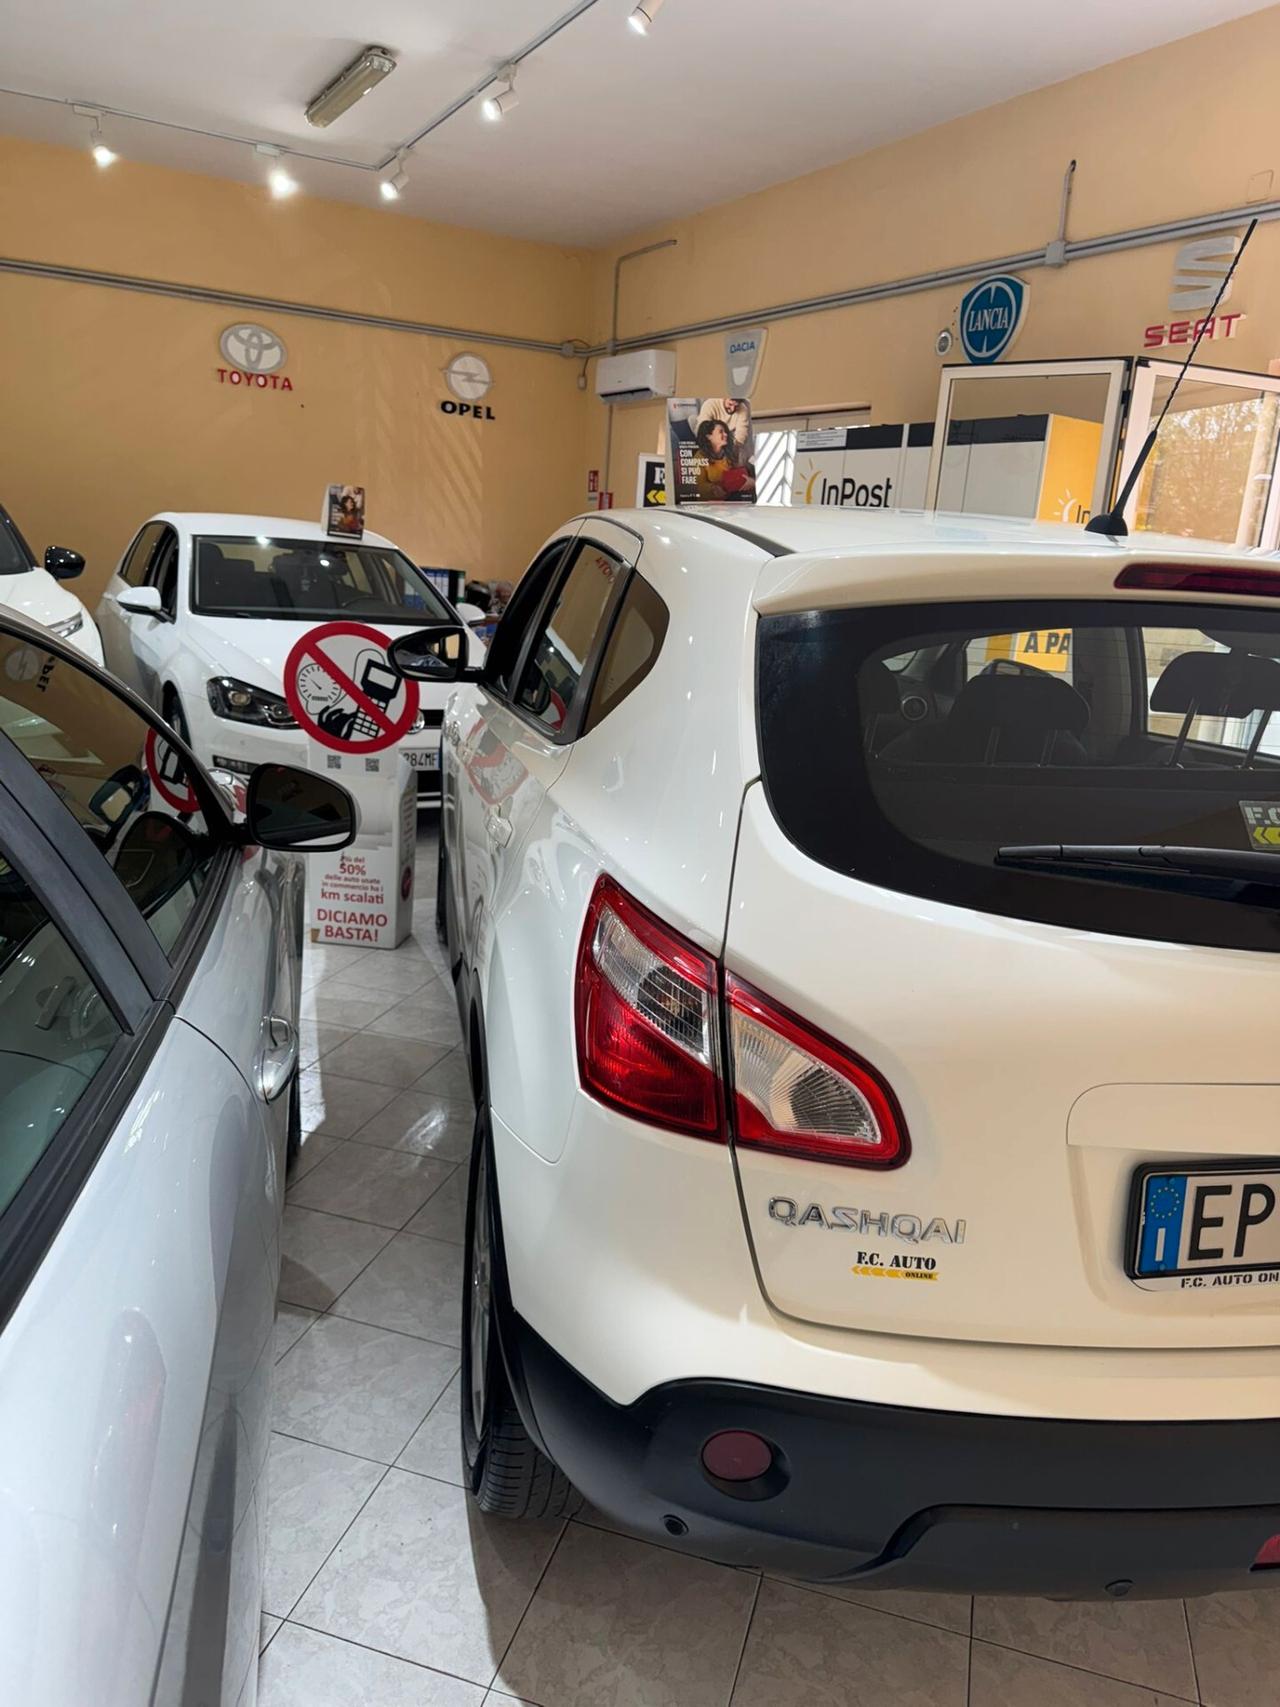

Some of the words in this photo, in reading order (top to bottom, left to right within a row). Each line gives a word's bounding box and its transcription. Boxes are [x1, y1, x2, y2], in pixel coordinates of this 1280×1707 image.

[968, 307, 1009, 332] LANCIA
[1144, 313, 1242, 348] SEAT
[729, 341, 755, 354] DACIA
[217, 368, 293, 391] TOYOTA
[440, 400, 496, 420] OPEL
[679, 449, 693, 458] CON
[680, 457, 709, 467] COMPASS
[681, 476, 697, 485] FARE
[820, 477, 893, 508] InPost
[1024, 632, 1039, 654] A
[339, 863, 367, 876] 50%
[321, 888, 341, 901] km
[343, 891, 385, 905] scalati
[317, 908, 388, 927] DICIAMO
[324, 925, 379, 942] BASTA!
[768, 1196, 966, 1244] QASHQAI
[1187, 1183, 1276, 1261] EP
[857, 1251, 884, 1267] F.C.
[889, 1255, 937, 1270] AUTO
[904, 1270, 934, 1280] ONLINE
[1181, 1277, 1206, 1288] F.C.
[1212, 1274, 1253, 1287] AUTO
